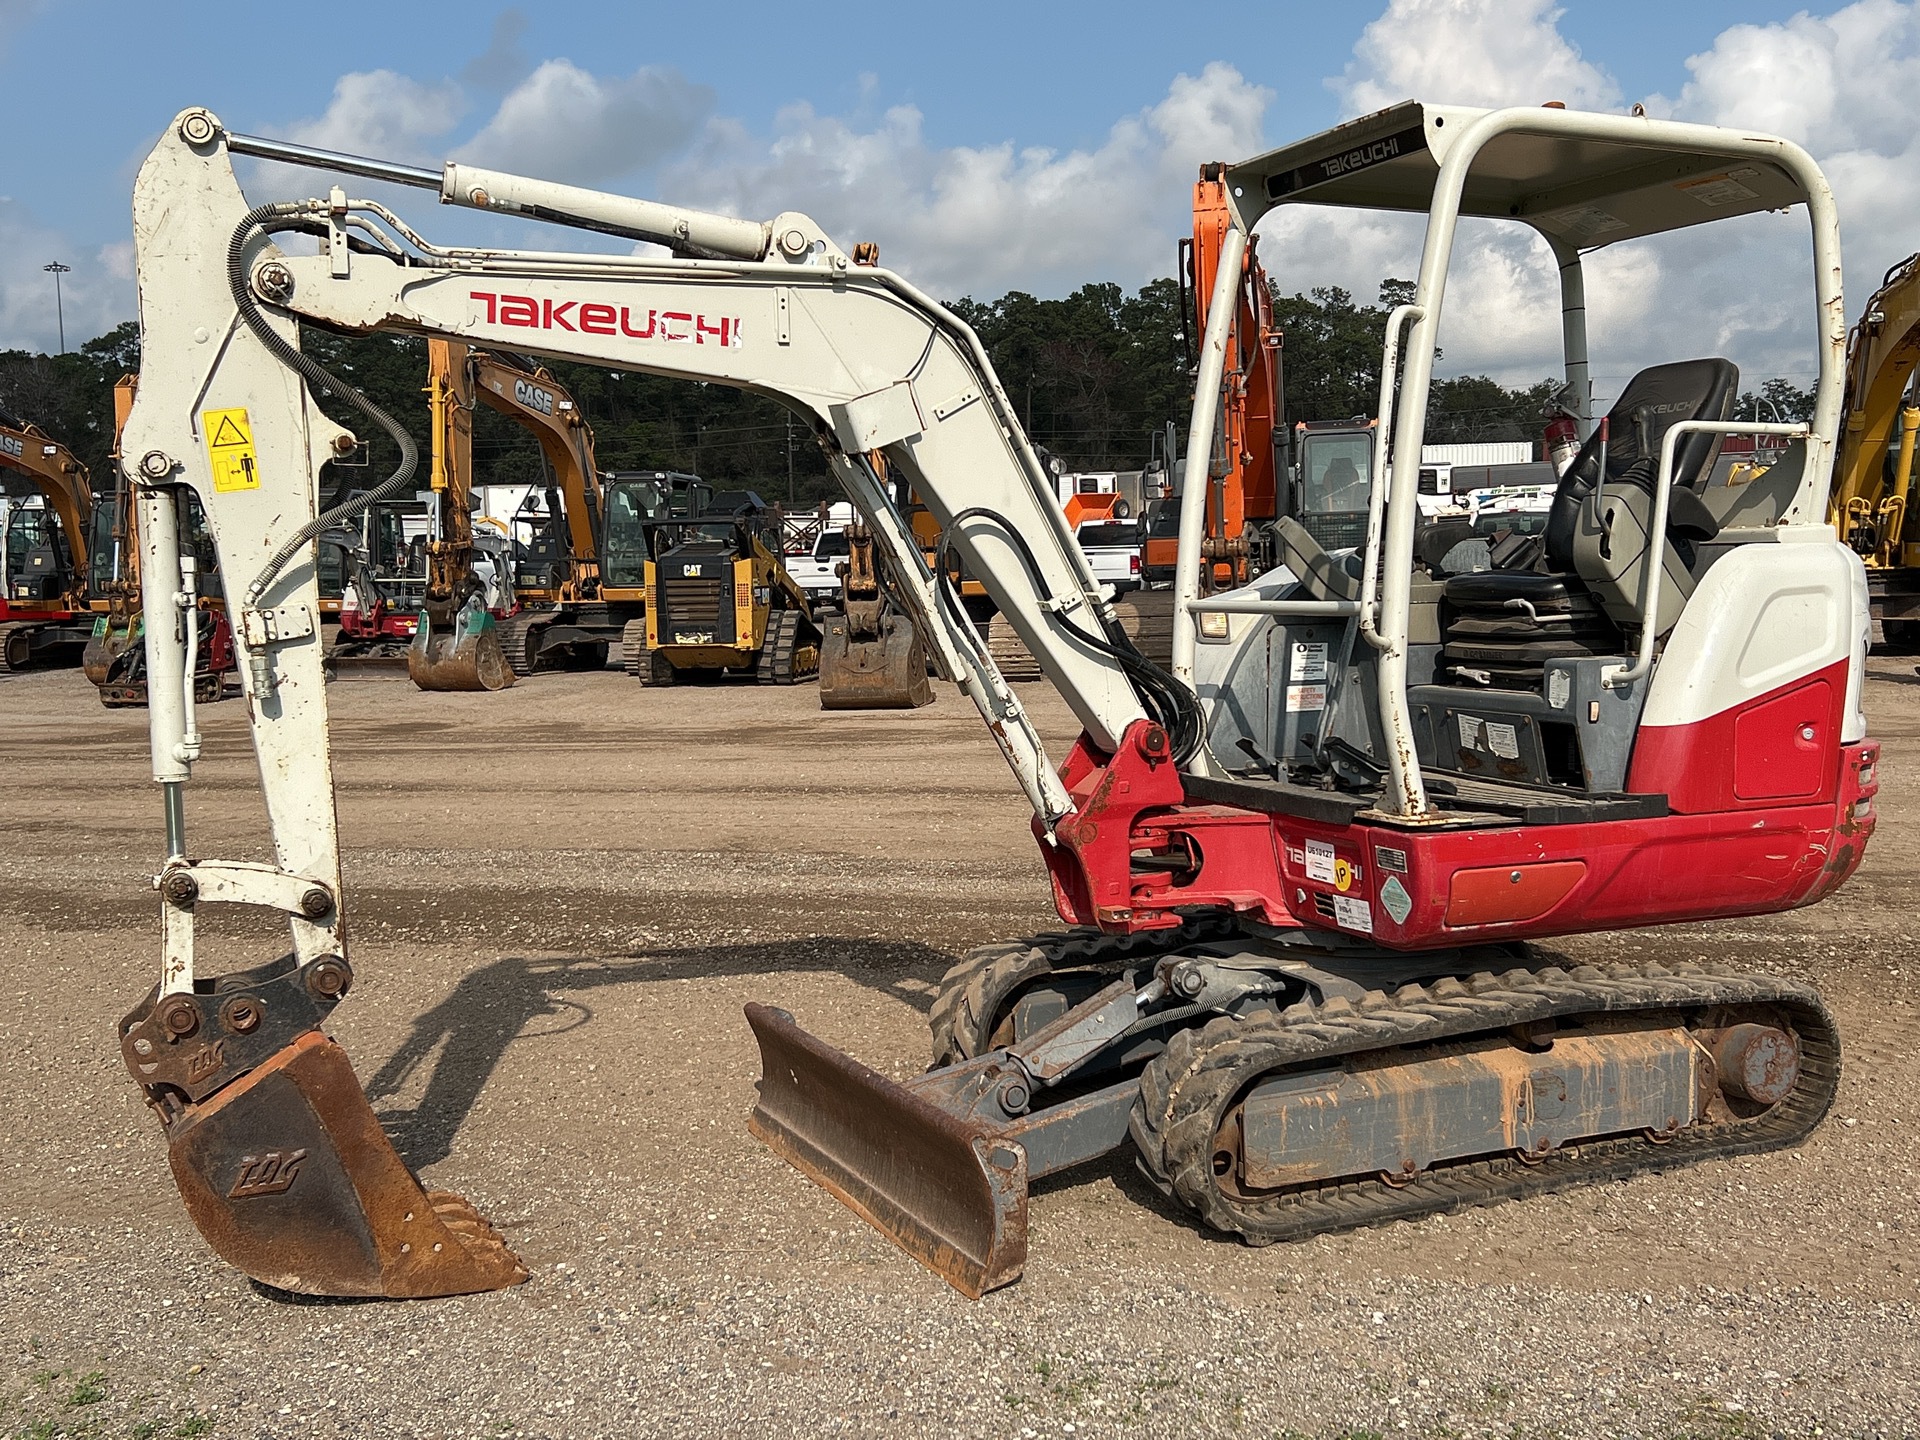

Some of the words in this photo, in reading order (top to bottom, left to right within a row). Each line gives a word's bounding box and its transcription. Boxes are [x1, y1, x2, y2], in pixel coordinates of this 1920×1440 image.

[1320, 137, 1400, 177] TAKEUCHI
[469, 291, 743, 348] TAKEUCHI
[514, 377, 554, 417] CASE
[1648, 400, 1696, 415] KEUCHI
[683, 564, 702, 577] CAT
